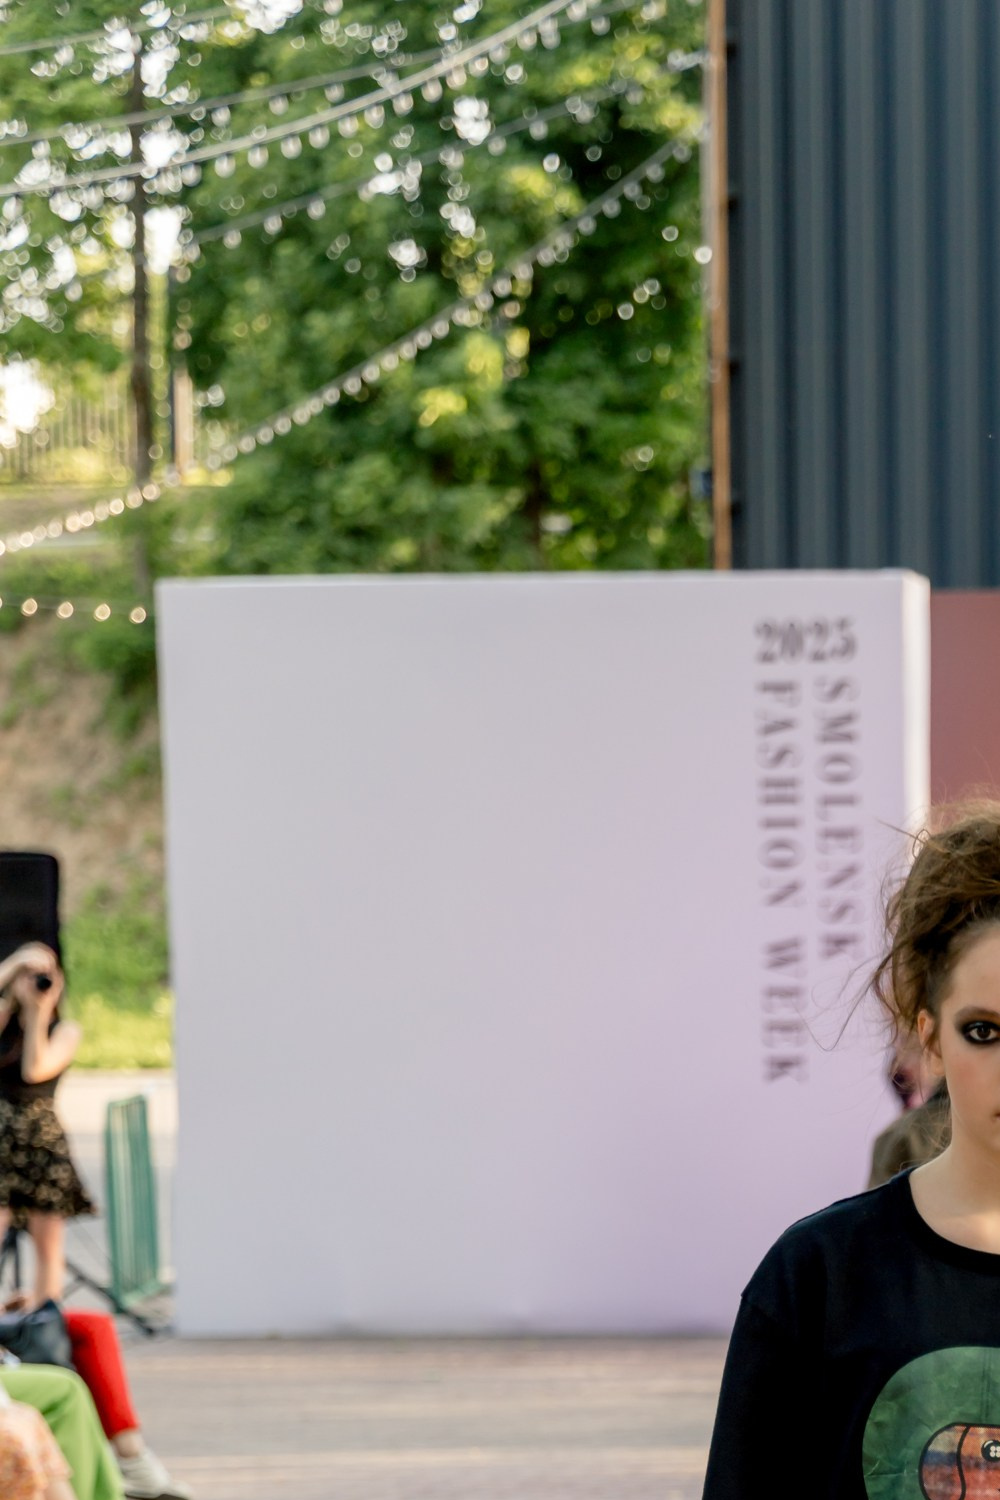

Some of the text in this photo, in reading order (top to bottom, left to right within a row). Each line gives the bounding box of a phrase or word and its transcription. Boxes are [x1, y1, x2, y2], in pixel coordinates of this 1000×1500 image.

[756, 617, 858, 665] 2025
[756, 679, 807, 1083] FASHION WEEK
[815, 676, 863, 961] SMOLENSK
